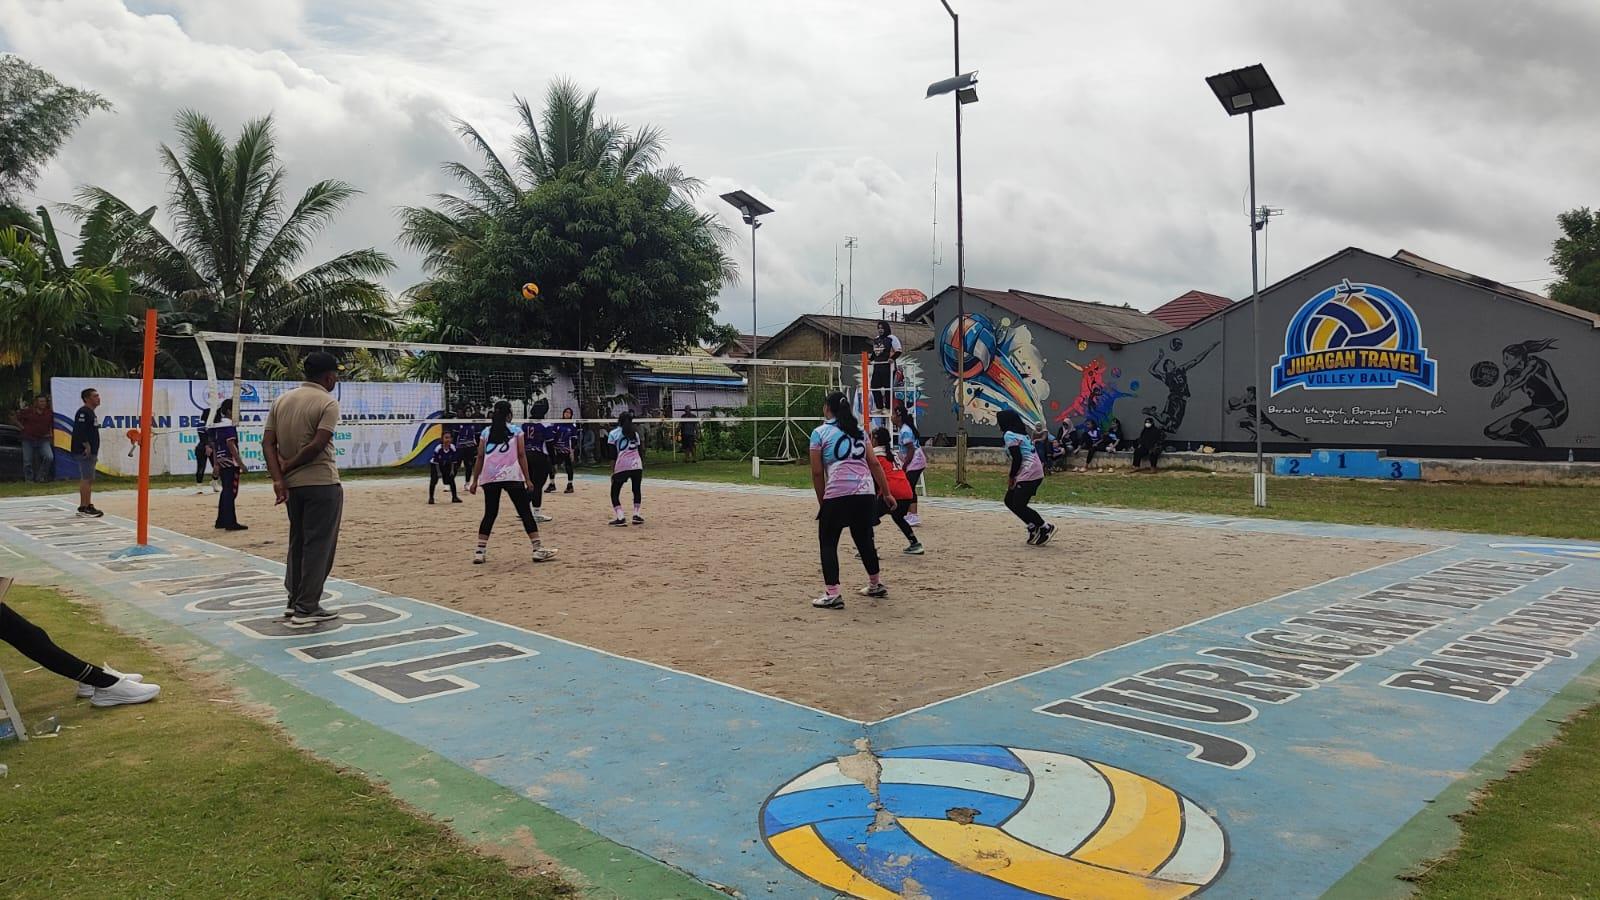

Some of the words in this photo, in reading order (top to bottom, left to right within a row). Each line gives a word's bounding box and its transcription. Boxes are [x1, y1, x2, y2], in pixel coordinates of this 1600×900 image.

[1287, 351, 1355, 375] JURAGAN
[1359, 350, 1419, 372] TRAVEL
[1308, 374, 1356, 384] VOLLEY
[1360, 372, 1396, 383] BALL
[100, 415, 171, 429] ATIHN
[1289, 459, 1300, 474] 2
[1338, 453, 1347, 468] 1
[1391, 461, 1403, 478] 3
[1033, 598, 1455, 770] JURAGAN
[1354, 557, 1574, 610] TRAVEL
